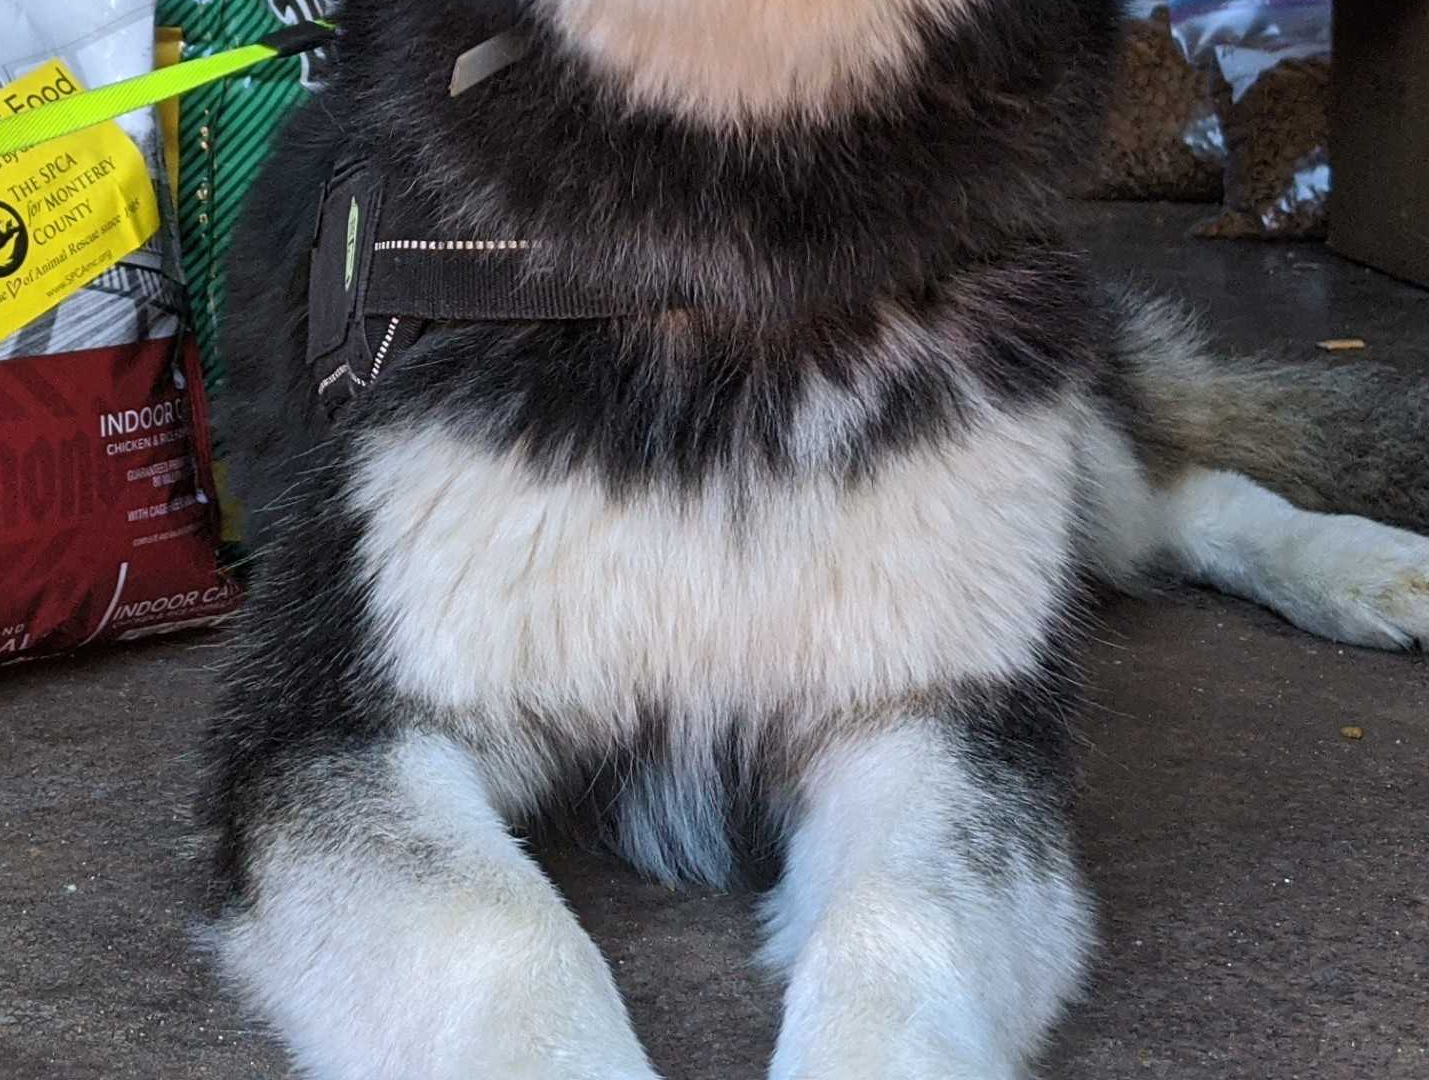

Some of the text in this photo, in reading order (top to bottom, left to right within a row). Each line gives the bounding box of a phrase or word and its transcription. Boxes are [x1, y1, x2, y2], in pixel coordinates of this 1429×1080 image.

[5, 67, 77, 113] Food
[3, 149, 21, 169] by
[7, 151, 78, 204] THE SPCA
[25, 155, 117, 227] for MONTEREY
[32, 198, 94, 246] COUNTY
[23, 270, 36, 287] of
[33, 249, 69, 279] Animal
[68, 233, 100, 257] Rescue
[100, 401, 172, 438] INDOOR
[106, 436, 152, 456] CHICKEN
[113, 590, 199, 621] INDOOR
